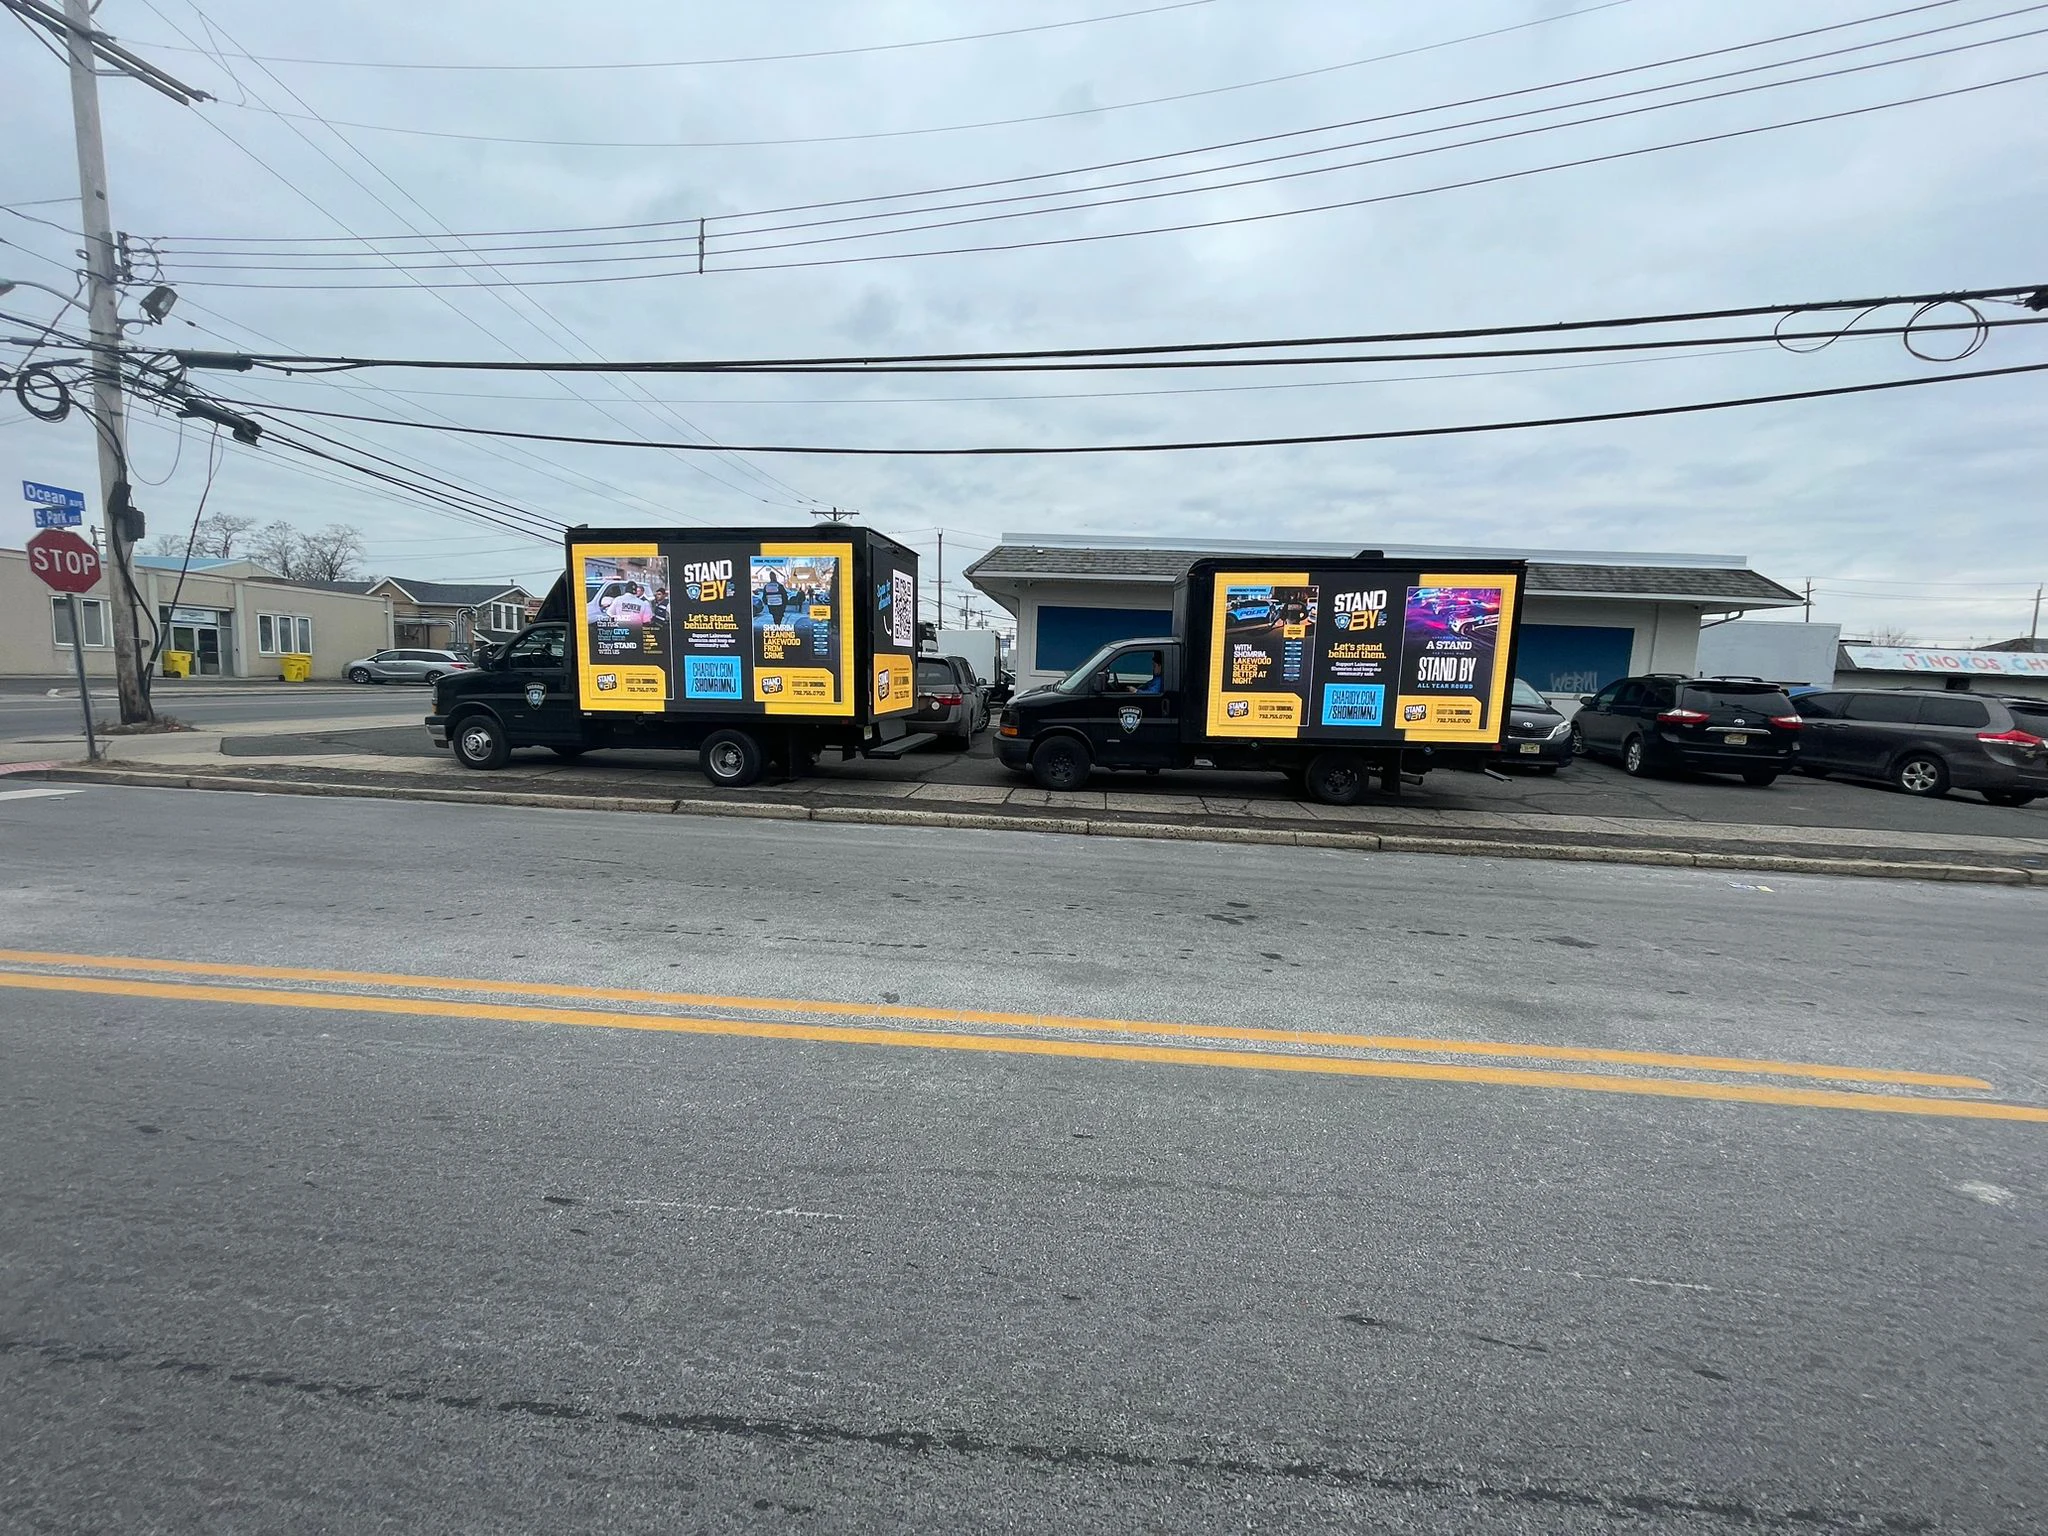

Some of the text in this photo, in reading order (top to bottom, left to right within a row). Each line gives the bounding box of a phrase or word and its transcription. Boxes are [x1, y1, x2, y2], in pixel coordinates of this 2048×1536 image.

[26, 484, 67, 505] Ocean
[47, 510, 67, 525] Park
[34, 546, 97, 576] STOP
[683, 559, 733, 583] STAND
[700, 579, 727, 602] BY
[1334, 590, 1387, 612] STAND
[688, 613, 734, 622] Let's stand
[1349, 609, 1379, 631] BY
[684, 621, 739, 630] behind them.
[763, 624, 795, 632] SHOMRIM
[763, 631, 796, 639] CLEANING
[598, 642, 613, 650] They
[763, 638, 801, 646] LAKEWOOD
[1334, 642, 1383, 651] Let's stand
[1426, 640, 1473, 650] A STAND
[1234, 643, 1252, 651] WITH
[764, 652, 785, 660] CRIME
[1328, 649, 1387, 659] behind them.
[1233, 657, 1272, 665] LAKEWOOD
[1417, 657, 1477, 682] STAND BY
[598, 674, 615, 683] STAND
[763, 677, 781, 686] STAND
[1228, 701, 1248, 710] STAND
[1405, 705, 1425, 713] STAND
